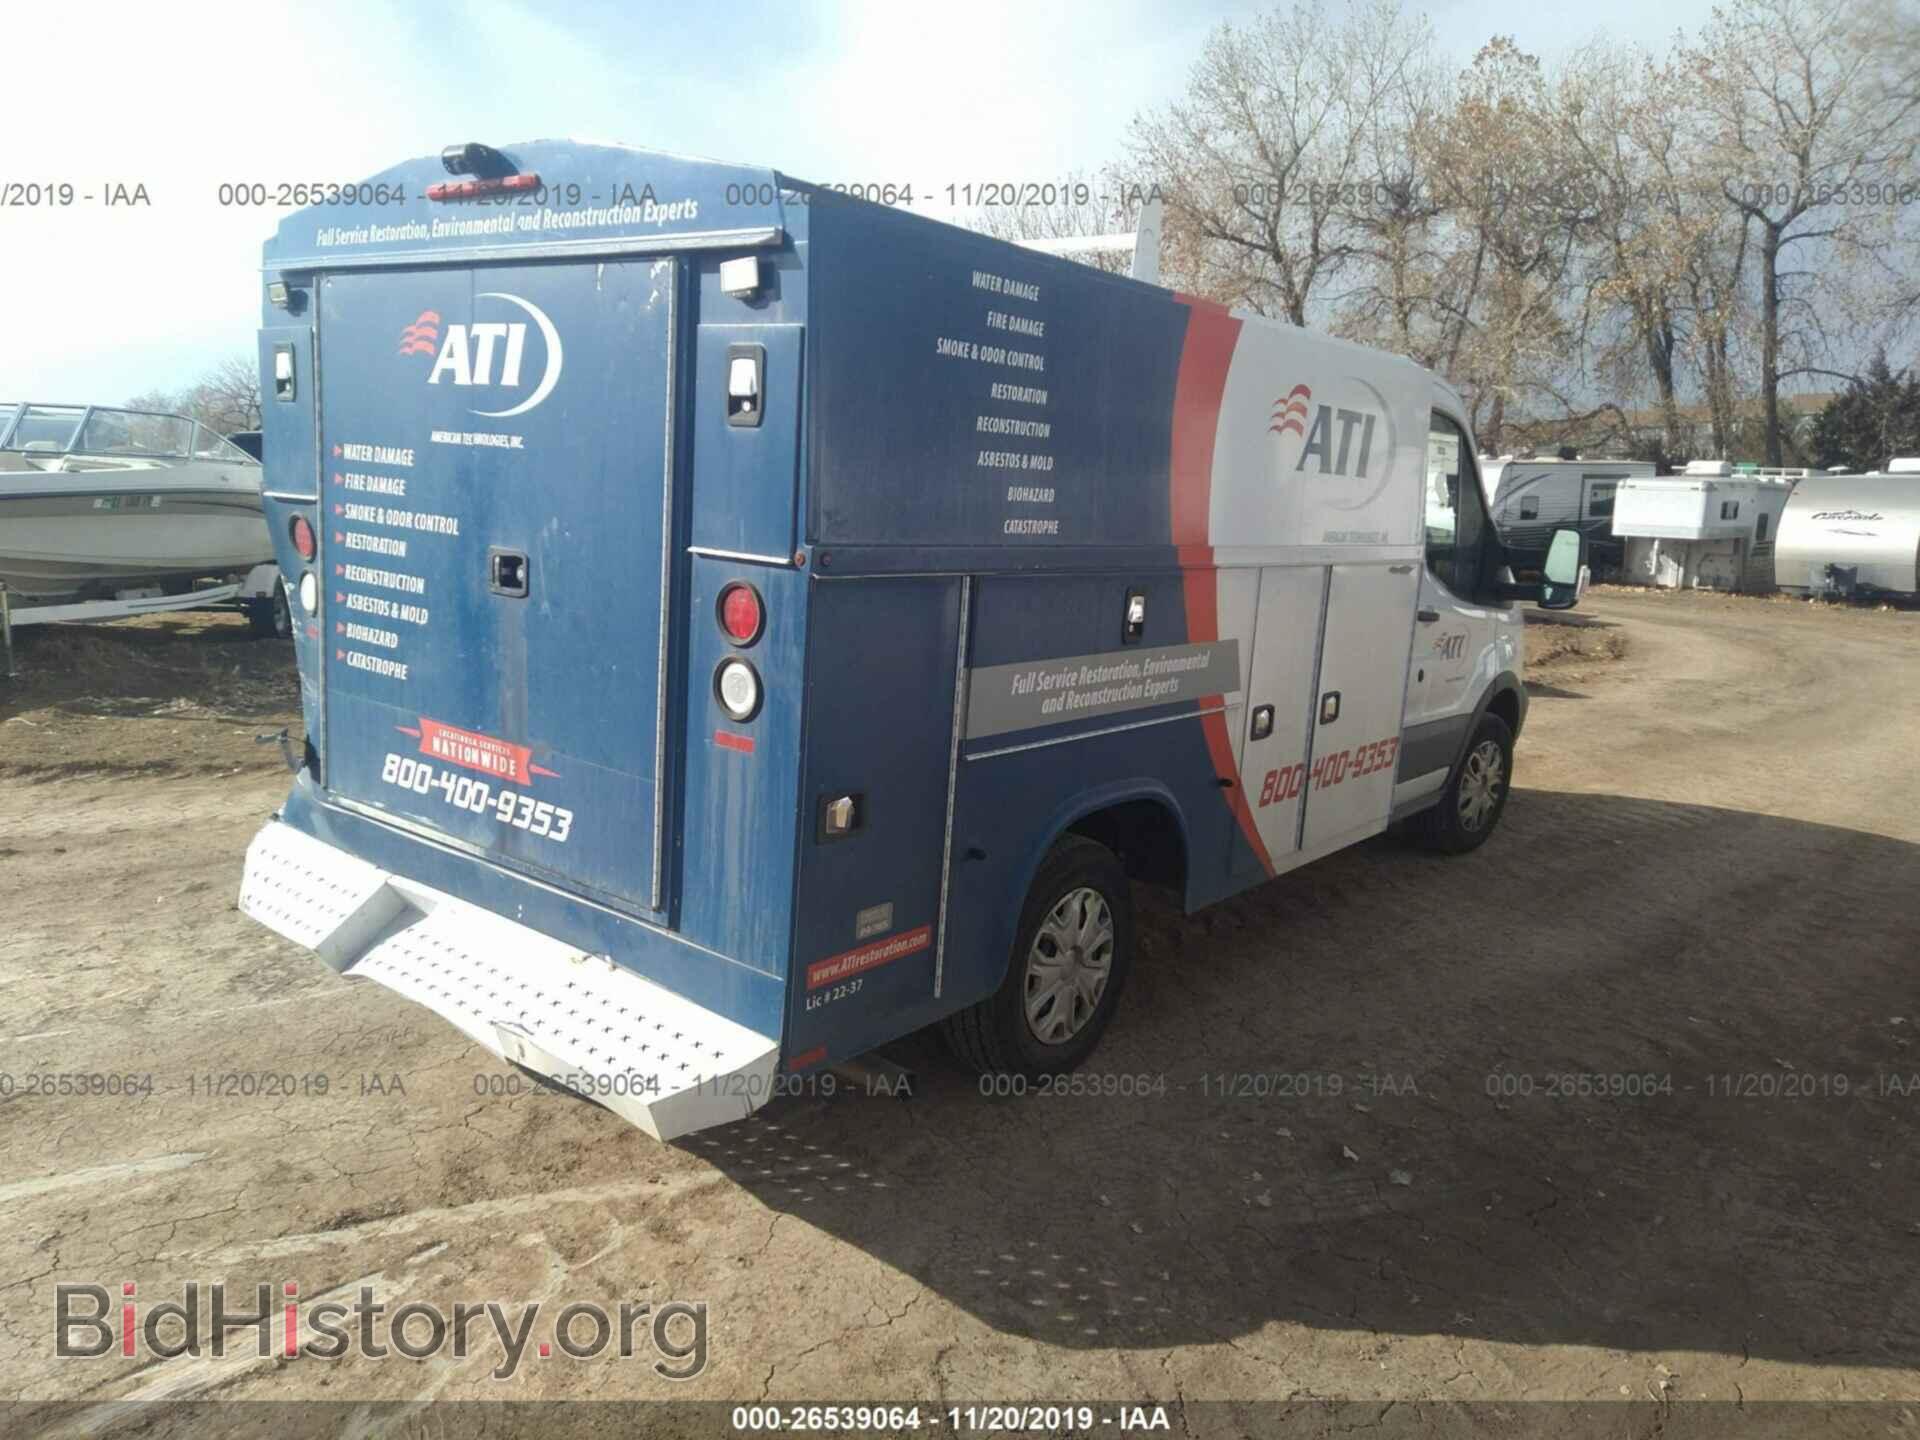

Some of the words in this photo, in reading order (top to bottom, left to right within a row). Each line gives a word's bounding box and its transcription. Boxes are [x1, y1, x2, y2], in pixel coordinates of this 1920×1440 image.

[316, 228, 335, 247] Full
[335, 224, 368, 246] Service
[370, 219, 430, 242] Restoration,
[432, 212, 513, 238] Environmental
[517, 208, 541, 232] and
[543, 203, 640, 230] Reconstruction
[644, 198, 698, 227] Experts
[972, 270, 1002, 293] WATER
[1003, 279, 1040, 302] DAMAGE
[987, 311, 1008, 330] FIRE
[1009, 315, 1045, 337] DAMAGE
[427, 323, 527, 386] ATI
[936, 337, 970, 359] SMOKE
[971, 344, 979, 361] &
[980, 345, 1006, 365] ODOR
[1007, 350, 1044, 371] CONTROL
[991, 383, 1048, 405] RESTORATION
[976, 416, 1051, 438] RECONSTRUCTION
[1295, 404, 1377, 478] ATI
[343, 443, 373, 461] WATER
[374, 446, 415, 467] DAMAGE
[976, 451, 1020, 469] ASBESTOS
[1022, 454, 1029, 469] &
[1029, 455, 1054, 471] MOLD
[345, 472, 366, 490] FIRE
[366, 475, 407, 496] DAMAGE
[1007, 486, 1056, 503] BIOHAZARD
[344, 503, 376, 524] SMOKE
[376, 507, 384, 525] &
[386, 509, 413, 529] ODOR
[414, 513, 459, 536] CONTROL
[1004, 519, 1059, 535] CATASTROPHE
[345, 532, 407, 557] RESTORATION
[344, 564, 425, 594] RECONSTRUCTION
[346, 593, 389, 617] ASBESTOS
[391, 602, 399, 619] &
[400, 604, 429, 625] MOLD
[346, 622, 399, 649] BIOHAZARD
[1440, 635, 1465, 660] ATI
[347, 651, 409, 680] CATASTROPHE
[1011, 671, 1036, 695] Full
[1036, 665, 1078, 692] Service
[1079, 659, 1140, 686] Restoration,
[1143, 650, 1210, 677] Environmental
[1041, 691, 1066, 715] and
[1066, 680, 1143, 711] Reconstruction
[1144, 676, 1180, 701] Experts
[432, 735, 517, 777] NATIONWIDE
[1259, 736, 1400, 808] 800-400-9353
[382, 753, 574, 842] 800-400-9353
[806, 995, 822, 1011] Lic
[832, 979, 864, 1001] 22-37
